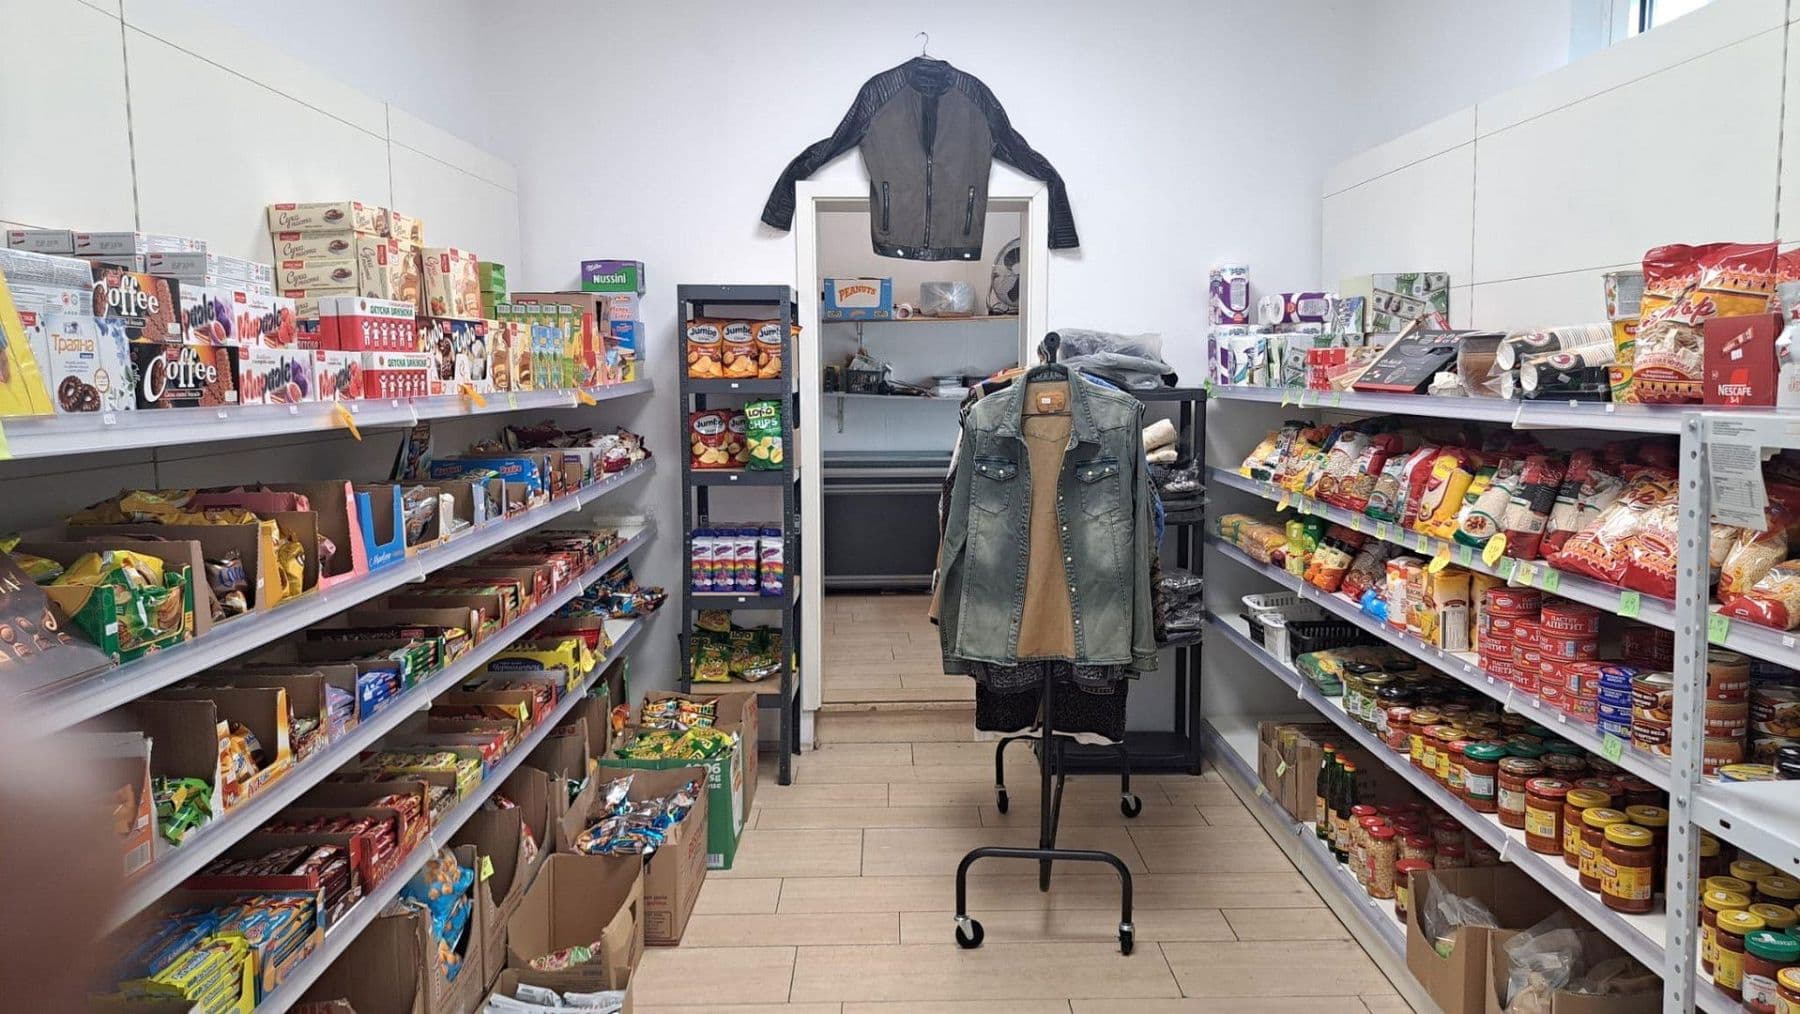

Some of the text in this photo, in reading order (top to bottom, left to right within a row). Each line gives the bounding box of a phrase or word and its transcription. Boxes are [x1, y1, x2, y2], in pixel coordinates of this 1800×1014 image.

[593, 272, 626, 284] Nussini
[838, 285, 877, 302] PEANUTS
[689, 326, 717, 337] Jumbo
[51, 334, 94, 354] Траяна
[143, 347, 217, 402] Coffee
